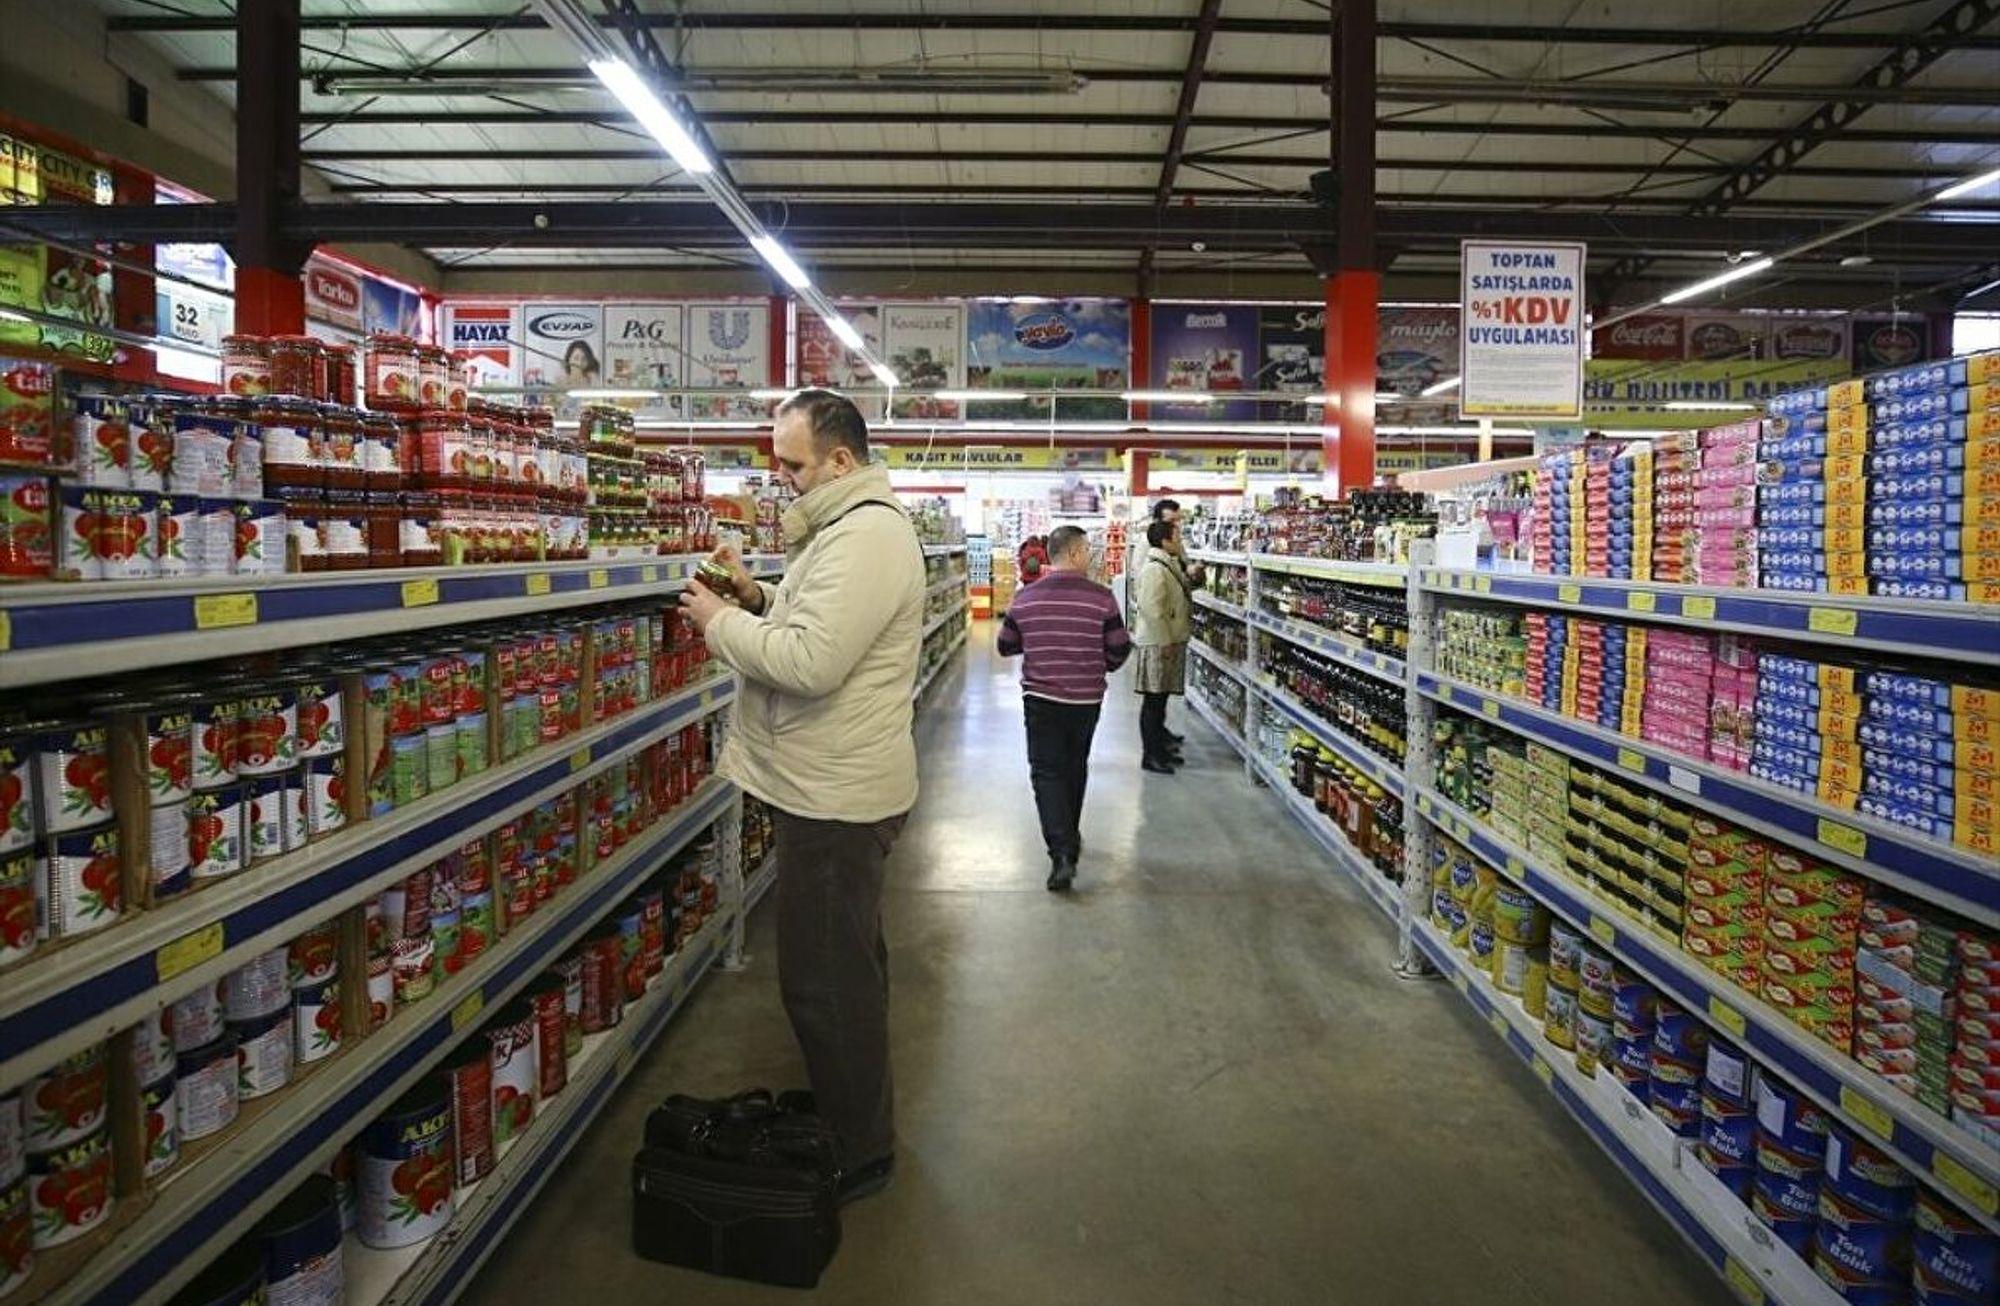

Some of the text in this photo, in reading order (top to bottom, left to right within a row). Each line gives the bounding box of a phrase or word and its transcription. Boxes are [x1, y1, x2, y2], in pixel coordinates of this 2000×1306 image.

[43, 153, 80, 183] CITY
[1491, 253, 1555, 268] TOPTAN
[316, 276, 355, 304] Torku
[1472, 275, 1572, 292] SATIŞLARDA
[175, 302, 199, 327] 32
[1472, 297, 1571, 324] %1 KDV
[453, 325, 510, 341] HAYAT
[540, 321, 595, 333] EVYAP
[622, 319, 665, 341] P&G
[1469, 327, 1575, 346] UYGULAMASI
[952, 452, 1023, 463] HAVLULAR
[1713, 1126, 1736, 1146] Ton
[1836, 1232, 1865, 1257] Ton
[1829, 1243, 1873, 1274] Balık
[1938, 1246, 1975, 1273] Ton
[1930, 1257, 1985, 1292] Balık
